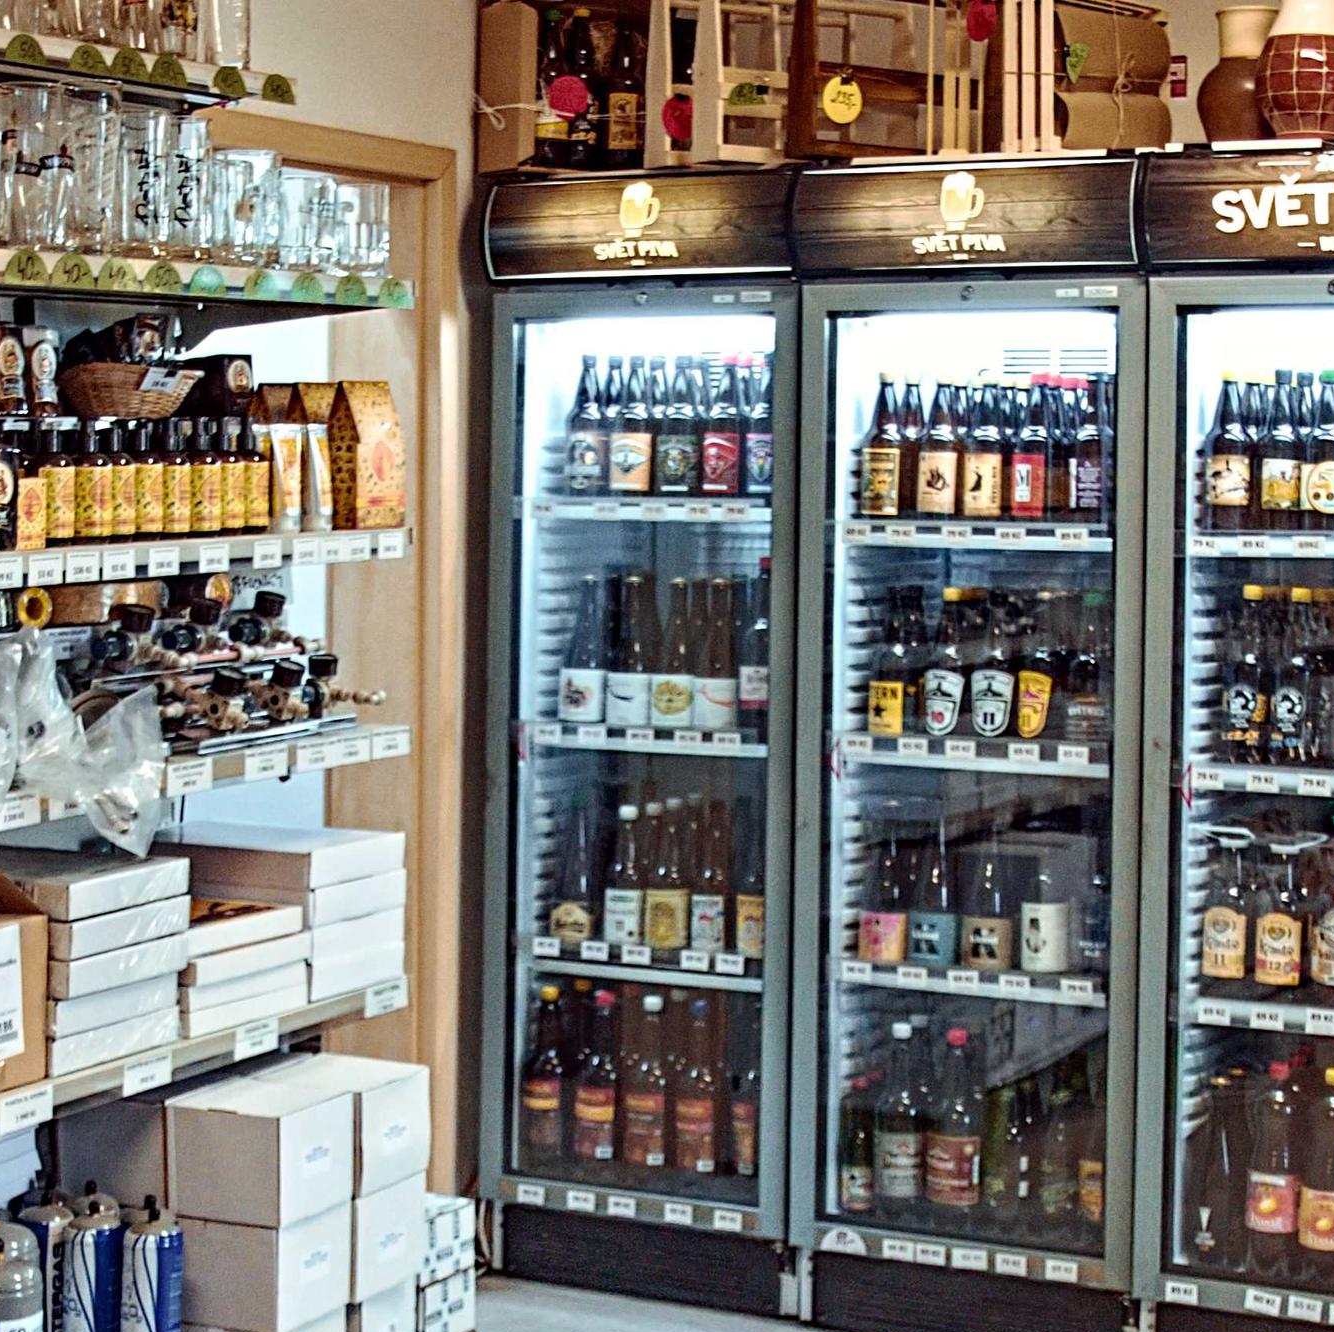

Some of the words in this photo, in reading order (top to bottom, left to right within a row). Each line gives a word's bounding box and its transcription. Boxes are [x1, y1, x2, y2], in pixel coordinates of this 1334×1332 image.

[594, 238, 637, 260] SVĚT
[639, 238, 678, 259] PIVA
[912, 231, 959, 256] SVĚT
[961, 233, 1005, 254] PIVA
